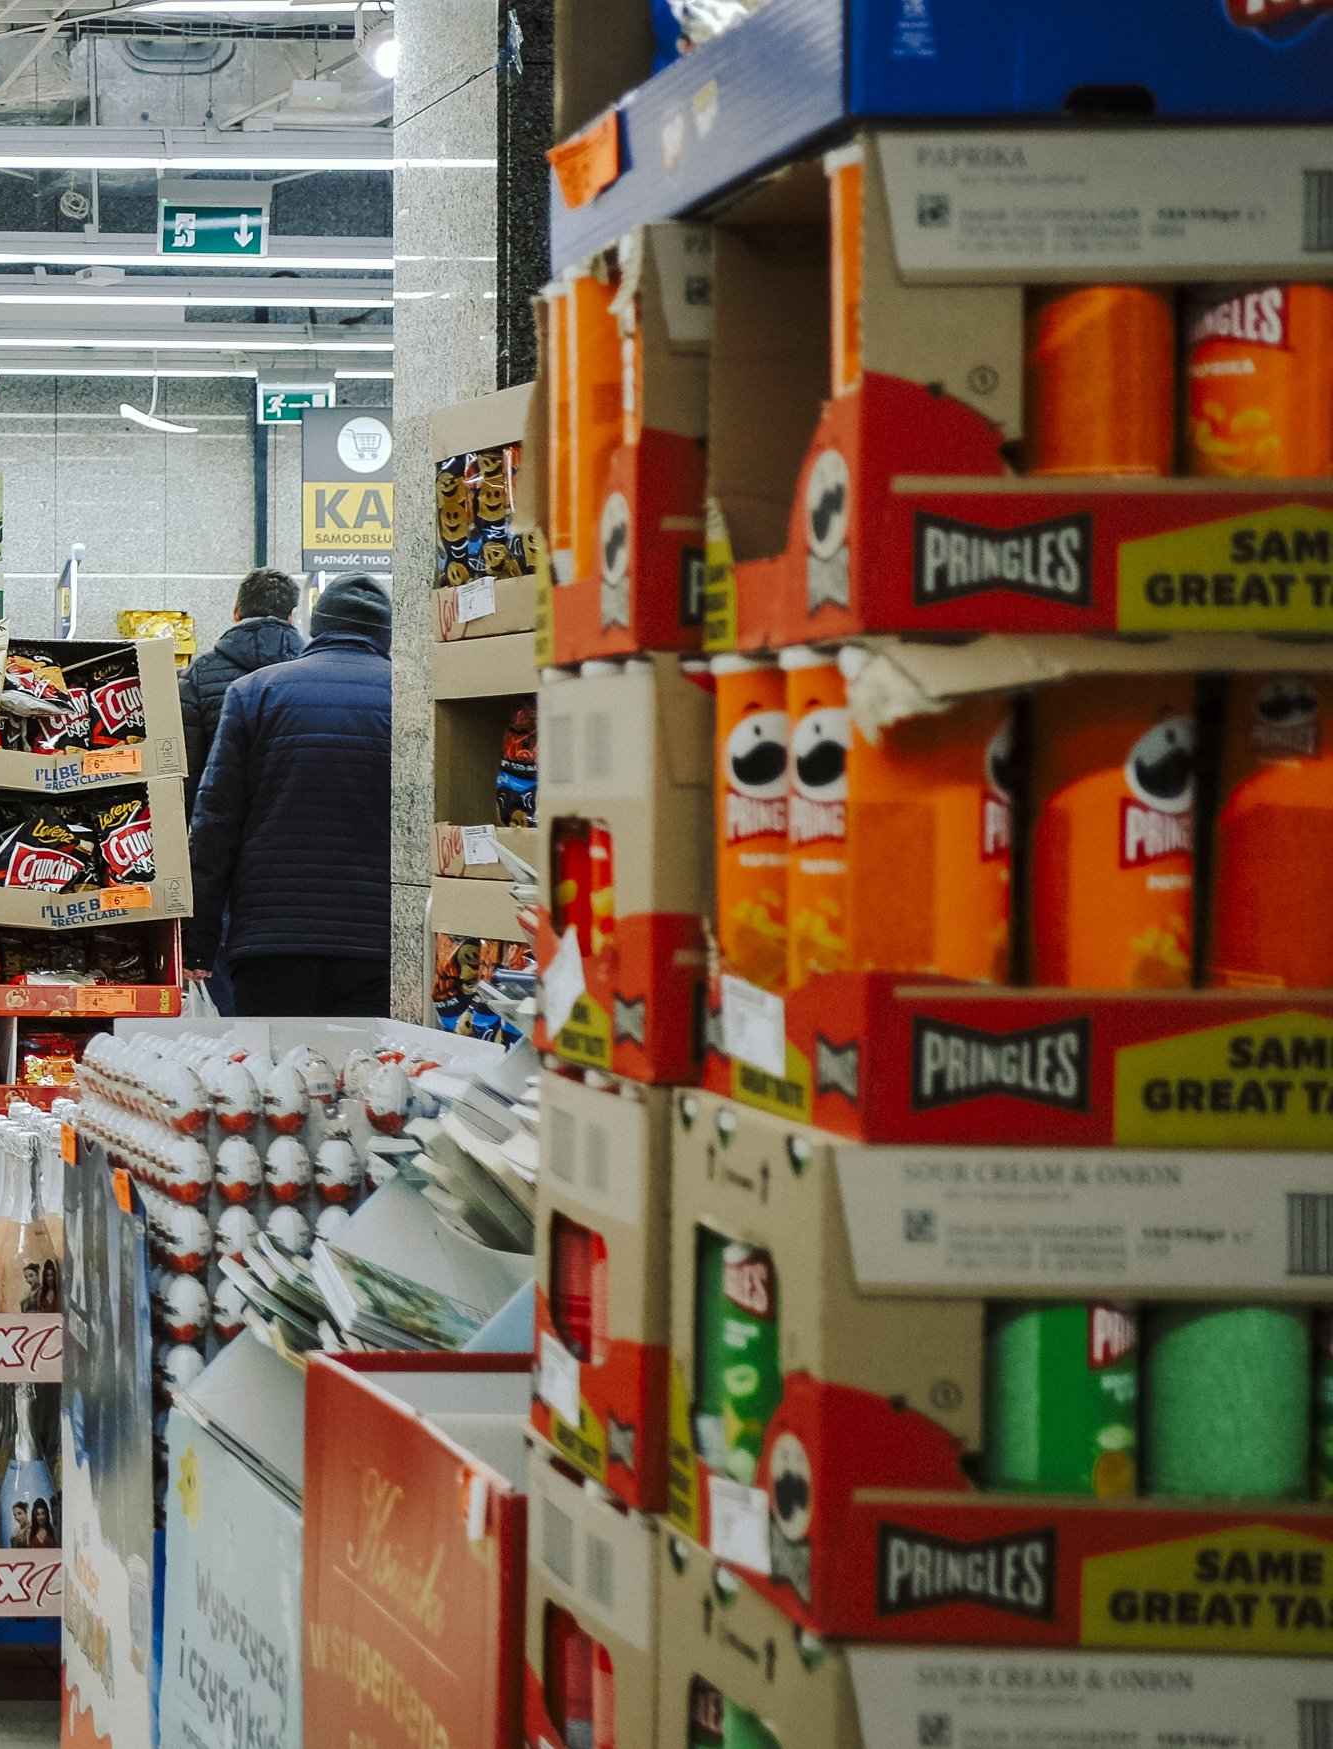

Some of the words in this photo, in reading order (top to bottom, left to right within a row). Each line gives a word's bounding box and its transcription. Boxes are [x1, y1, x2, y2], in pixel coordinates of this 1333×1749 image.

[917, 146, 1027, 167] PAPRIKA
[314, 553, 361, 566] PŁATNOŚĆ
[362, 555, 390, 565] TYLKO
[923, 525, 1083, 594] PRINGLES
[1144, 573, 1295, 608] GREAT
[59, 764, 79, 779] BE
[32, 818, 75, 843] Lorenz
[41, 905, 65, 918] I'LL
[68, 901, 87, 916] BE
[51, 907, 129, 928] #RECYCLABLE
[921, 1029, 1080, 1098] PRINGLES
[1142, 1078, 1294, 1114] GREAT
[903, 1163, 969, 1186] SOUR
[974, 1163, 1064, 1186] CREAM
[1070, 1163, 1090, 1186] &
[1095, 1163, 1183, 1187] ONION
[888, 1536, 1046, 1608] PRINGLES
[1195, 1548, 1325, 1587] SAME
[1109, 1589, 1259, 1627] GREAT
[916, 1665, 982, 1690] SOUR
[989, 1666, 1080, 1691] CREAM
[1085, 1667, 1105, 1692] &
[1110, 1667, 1194, 1693] ONION
